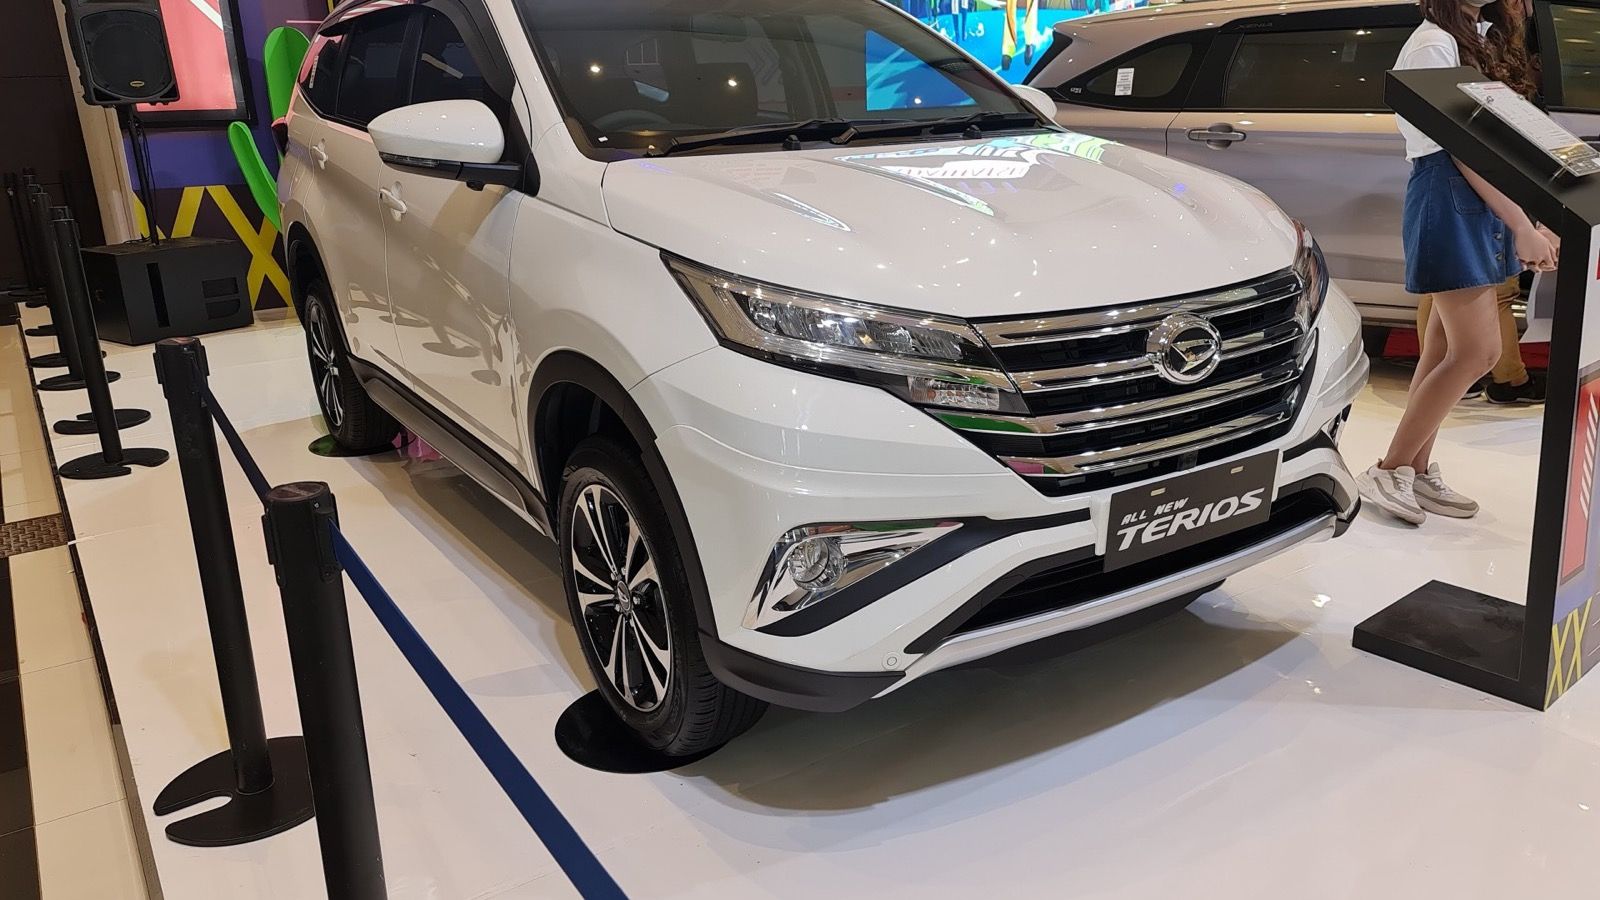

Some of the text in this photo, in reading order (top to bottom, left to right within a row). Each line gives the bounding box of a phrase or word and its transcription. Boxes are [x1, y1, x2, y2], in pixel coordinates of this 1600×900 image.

[1116, 487, 1265, 551] TERIOS
[1120, 497, 1189, 526] ALL NEW
